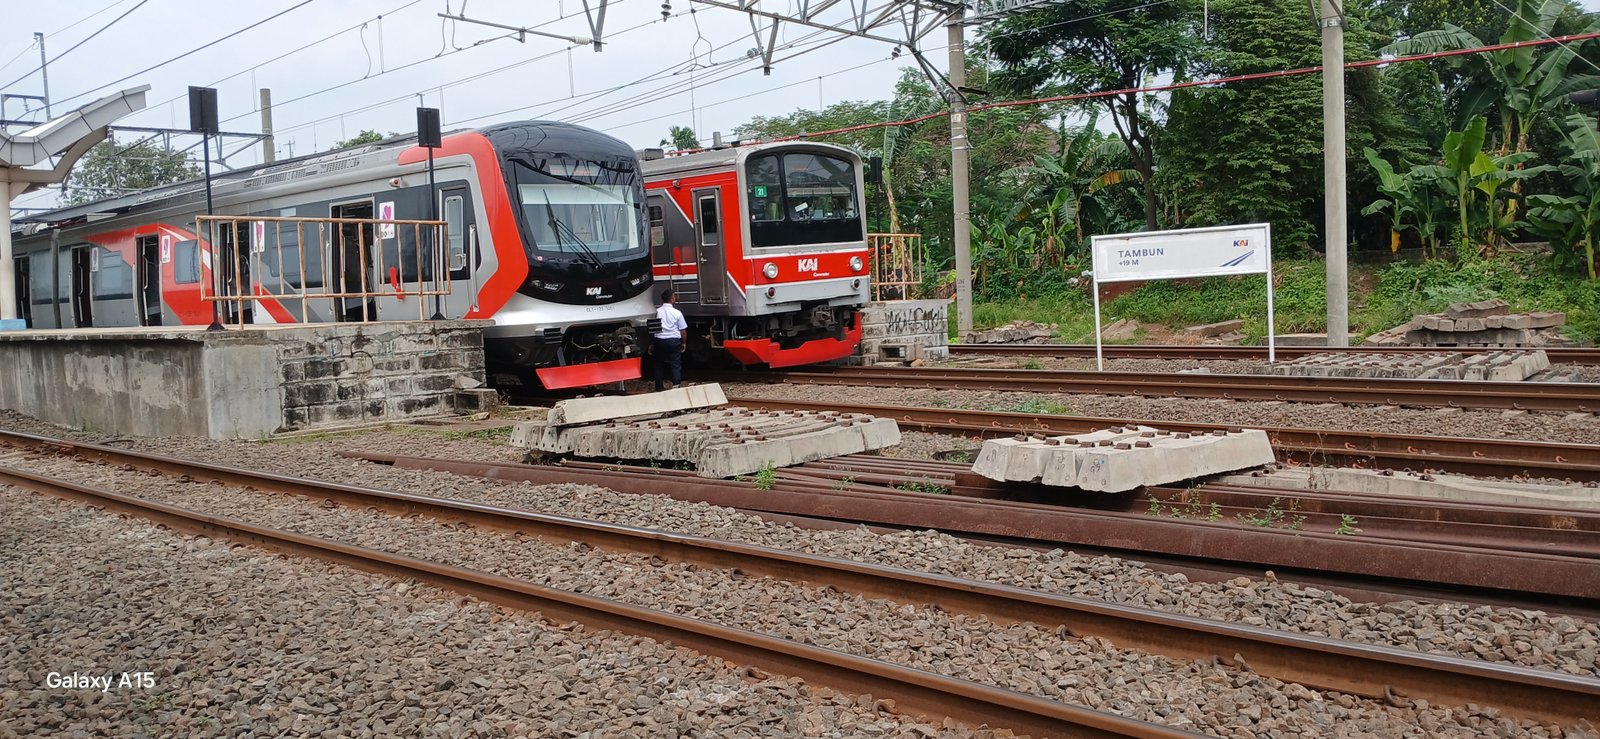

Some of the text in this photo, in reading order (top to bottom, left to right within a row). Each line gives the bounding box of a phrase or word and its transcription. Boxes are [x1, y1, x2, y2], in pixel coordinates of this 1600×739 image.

[1117, 248, 1164, 258] TAMBUN
[798, 258, 818, 272] KAI
[586, 287, 602, 295] KAI
